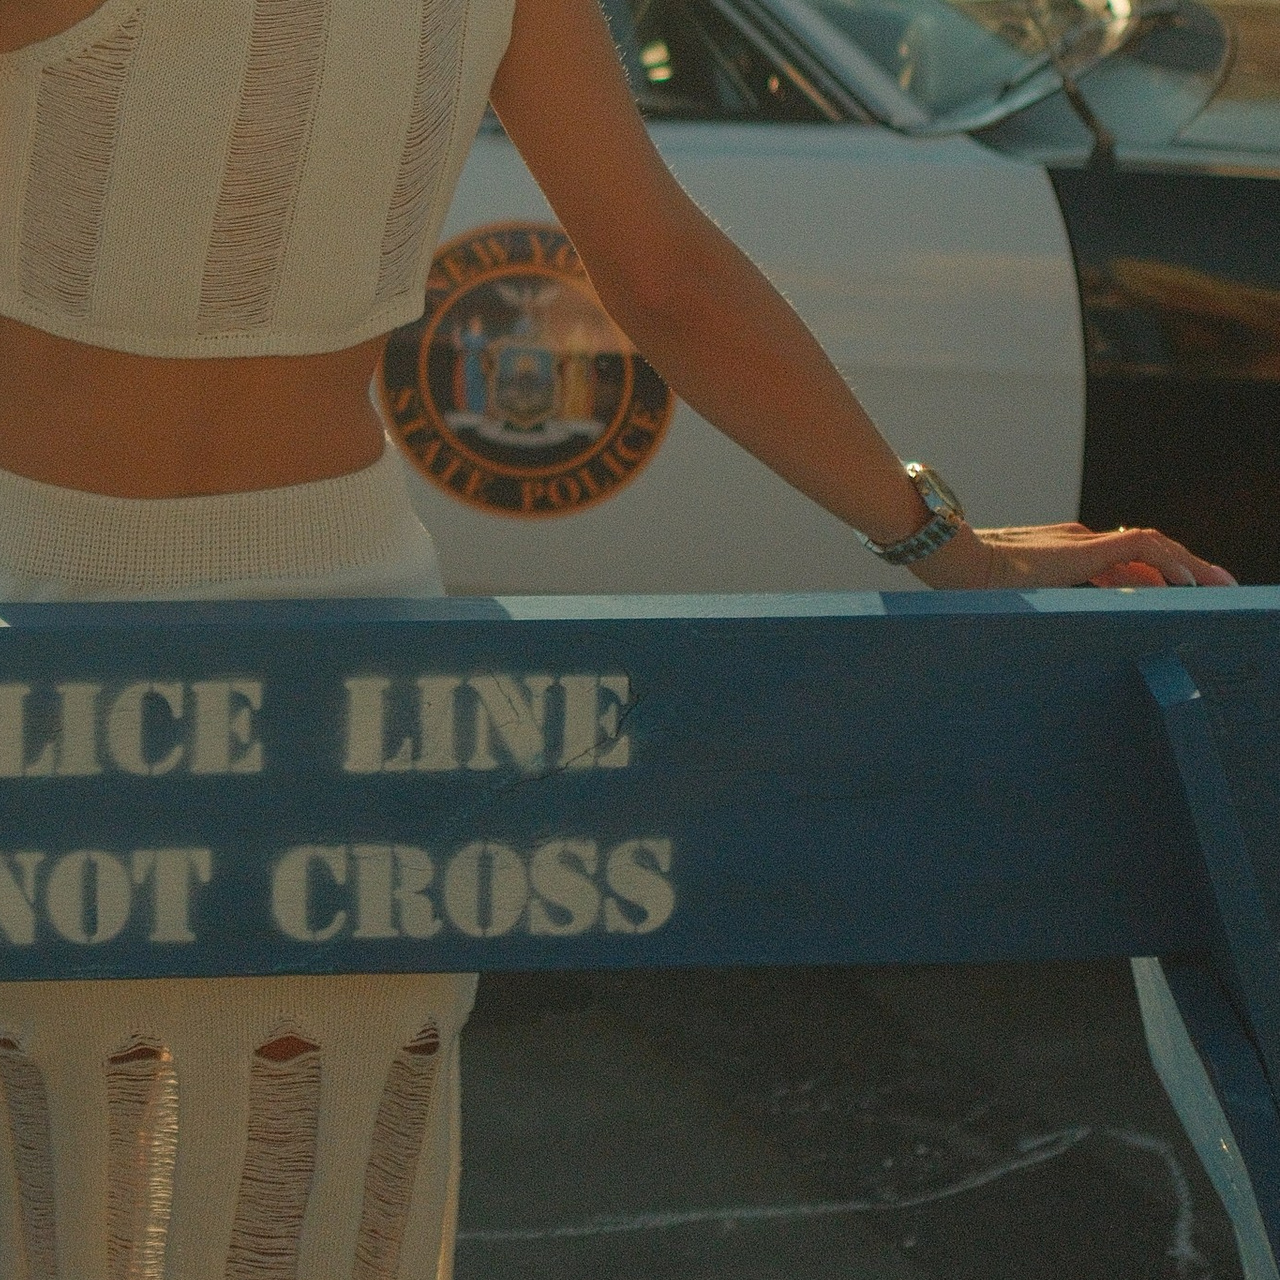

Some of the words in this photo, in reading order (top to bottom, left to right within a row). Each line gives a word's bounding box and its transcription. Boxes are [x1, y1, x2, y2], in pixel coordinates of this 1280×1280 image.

[384, 386, 492, 502] STATE
[521, 400, 668, 512] POLICE
[342, 672, 634, 774] LINE
[269, 835, 678, 943] CROSS
